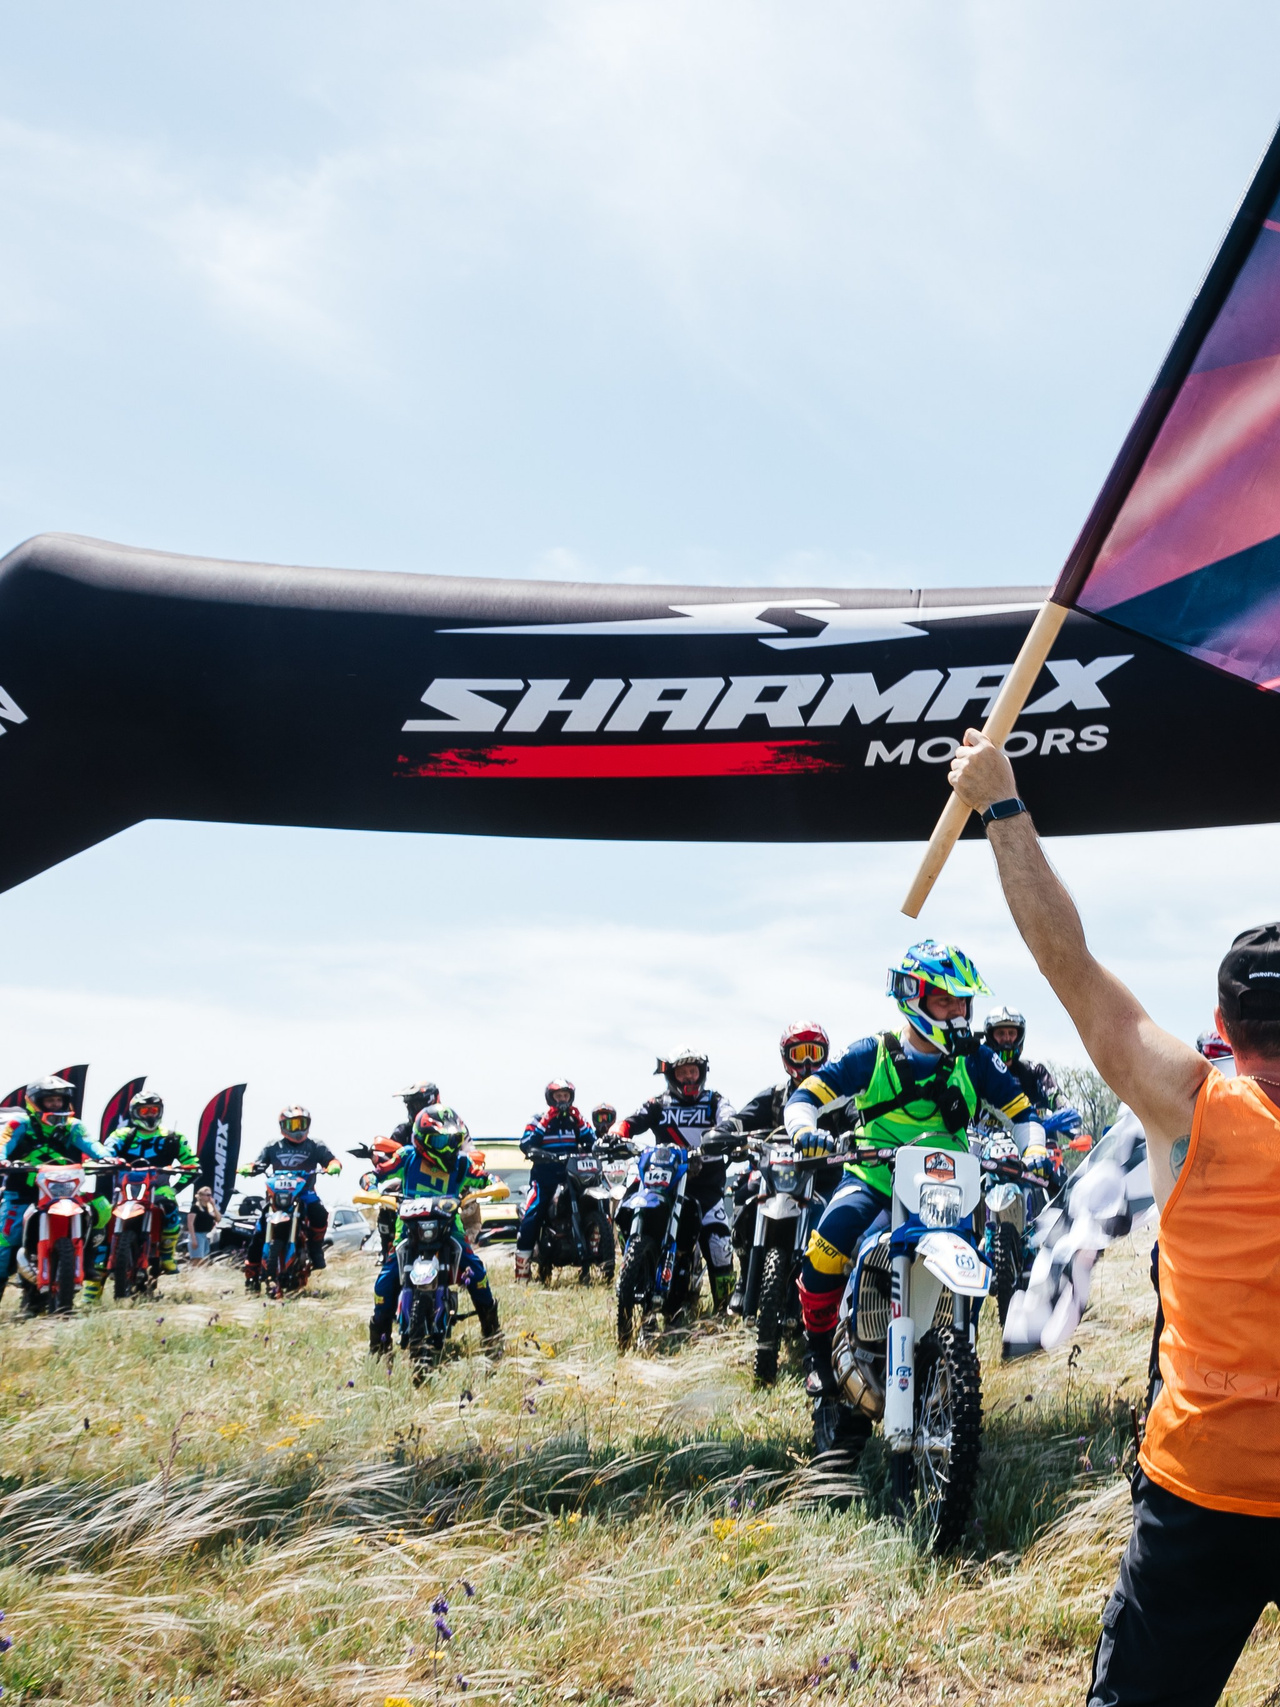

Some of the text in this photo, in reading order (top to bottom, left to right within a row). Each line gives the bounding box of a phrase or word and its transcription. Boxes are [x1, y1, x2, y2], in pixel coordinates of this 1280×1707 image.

[401, 654, 1135, 733] SHARMAX
[864, 724, 1110, 767] MOORS
[648, 1172, 668, 1182] 145
[815, 1239, 840, 1259] SHOT
[1203, 1371, 1239, 1392] CK
